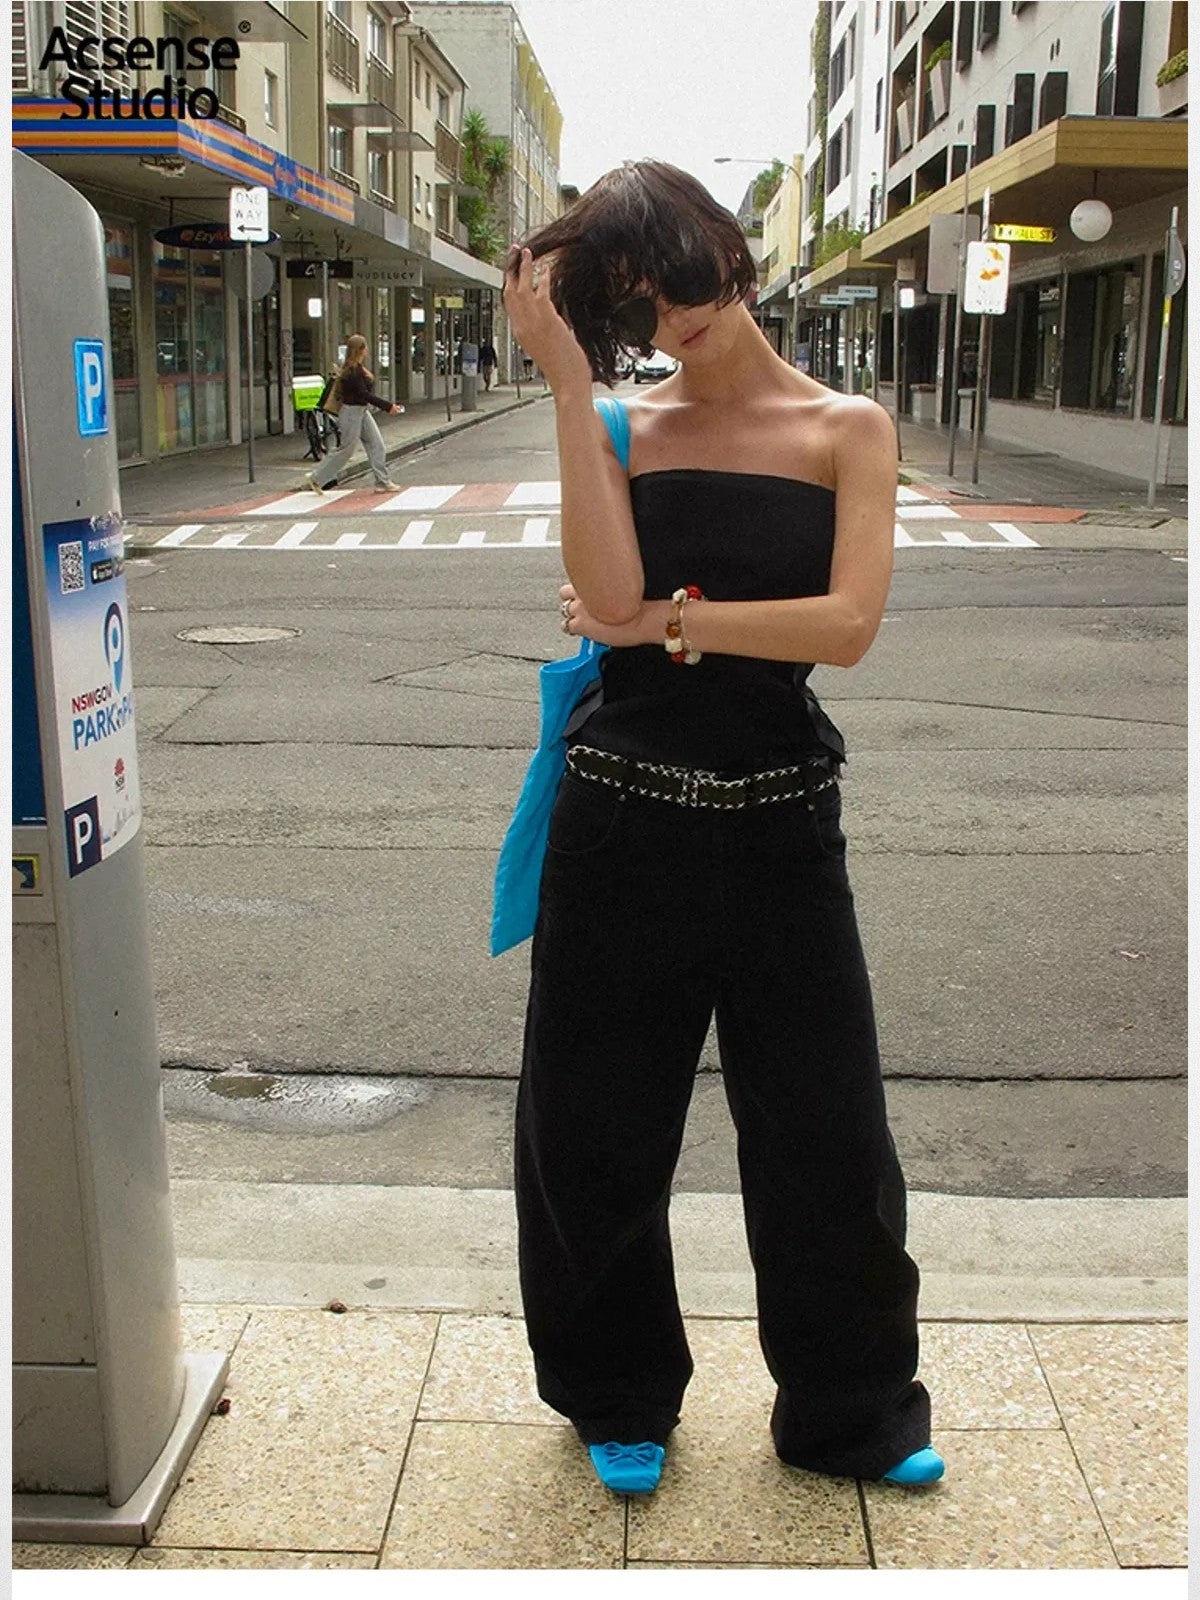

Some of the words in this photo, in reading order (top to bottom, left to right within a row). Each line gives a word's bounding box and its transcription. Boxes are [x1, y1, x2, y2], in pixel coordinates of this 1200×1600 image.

[235, 209, 262, 219] WAY
[194, 230, 231, 243] EzyM
[83, 352, 102, 424] P
[73, 812, 93, 864] P
